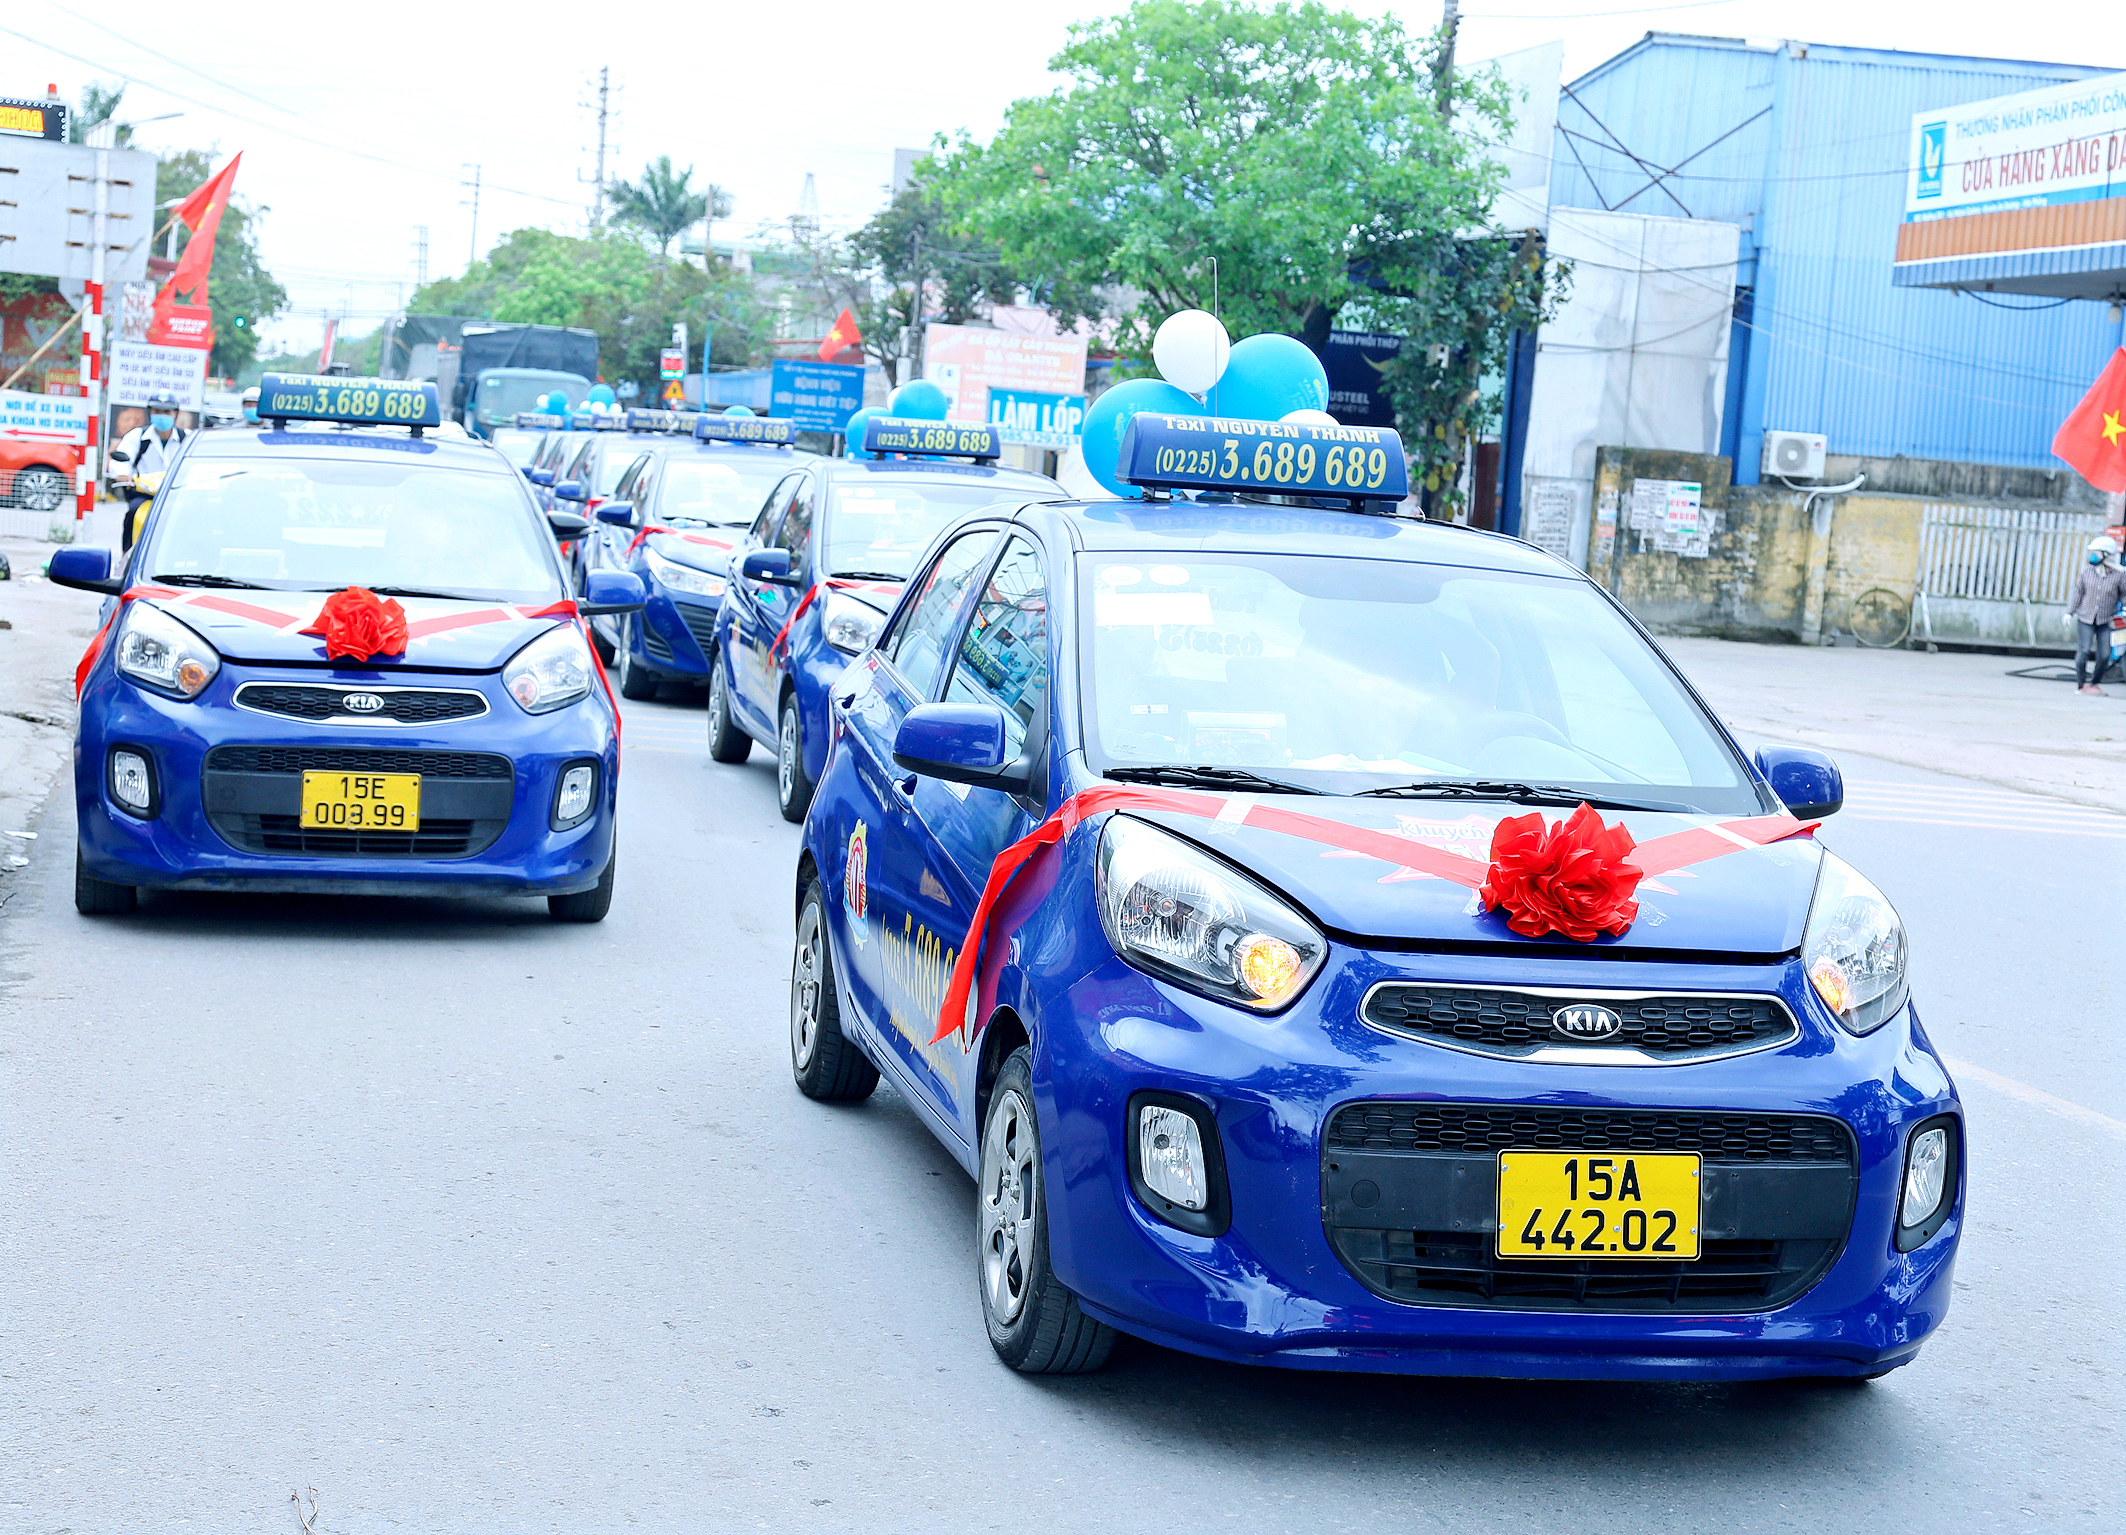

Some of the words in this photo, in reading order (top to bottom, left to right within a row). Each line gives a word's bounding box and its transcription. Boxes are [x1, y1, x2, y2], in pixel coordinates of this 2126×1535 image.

[2002, 107, 2034, 131] NHÂN
[2000, 146, 2045, 187] HÀNG
[2051, 136, 2100, 180] XĂNG
[278, 377, 307, 386] Taxi
[272, 393, 313, 413] (0225)
[314, 388, 379, 417] 3.689
[384, 392, 427, 419] 689
[991, 395, 1038, 431] LÀM
[1042, 396, 1082, 435] LỐP
[727, 422, 762, 439] 3.689
[765, 424, 789, 441] 689
[877, 432, 909, 448] (0225)
[908, 428, 957, 451] 3.689
[959, 431, 991, 453] 689
[1163, 416, 1206, 432] Taxi
[1213, 420, 1299, 438] NGUYEN
[1306, 426, 1380, 443] THANH
[1155, 445, 1217, 479] (0225)
[1219, 438, 1316, 483] 3.689
[1324, 446, 1387, 489] 689
[341, 777, 386, 800] 15E
[315, 802, 405, 826] 003.99
[1564, 1010, 1613, 1032] KIA
[1564, 1159, 1642, 1201] 15A
[1520, 1208, 1677, 1252] 442.02
